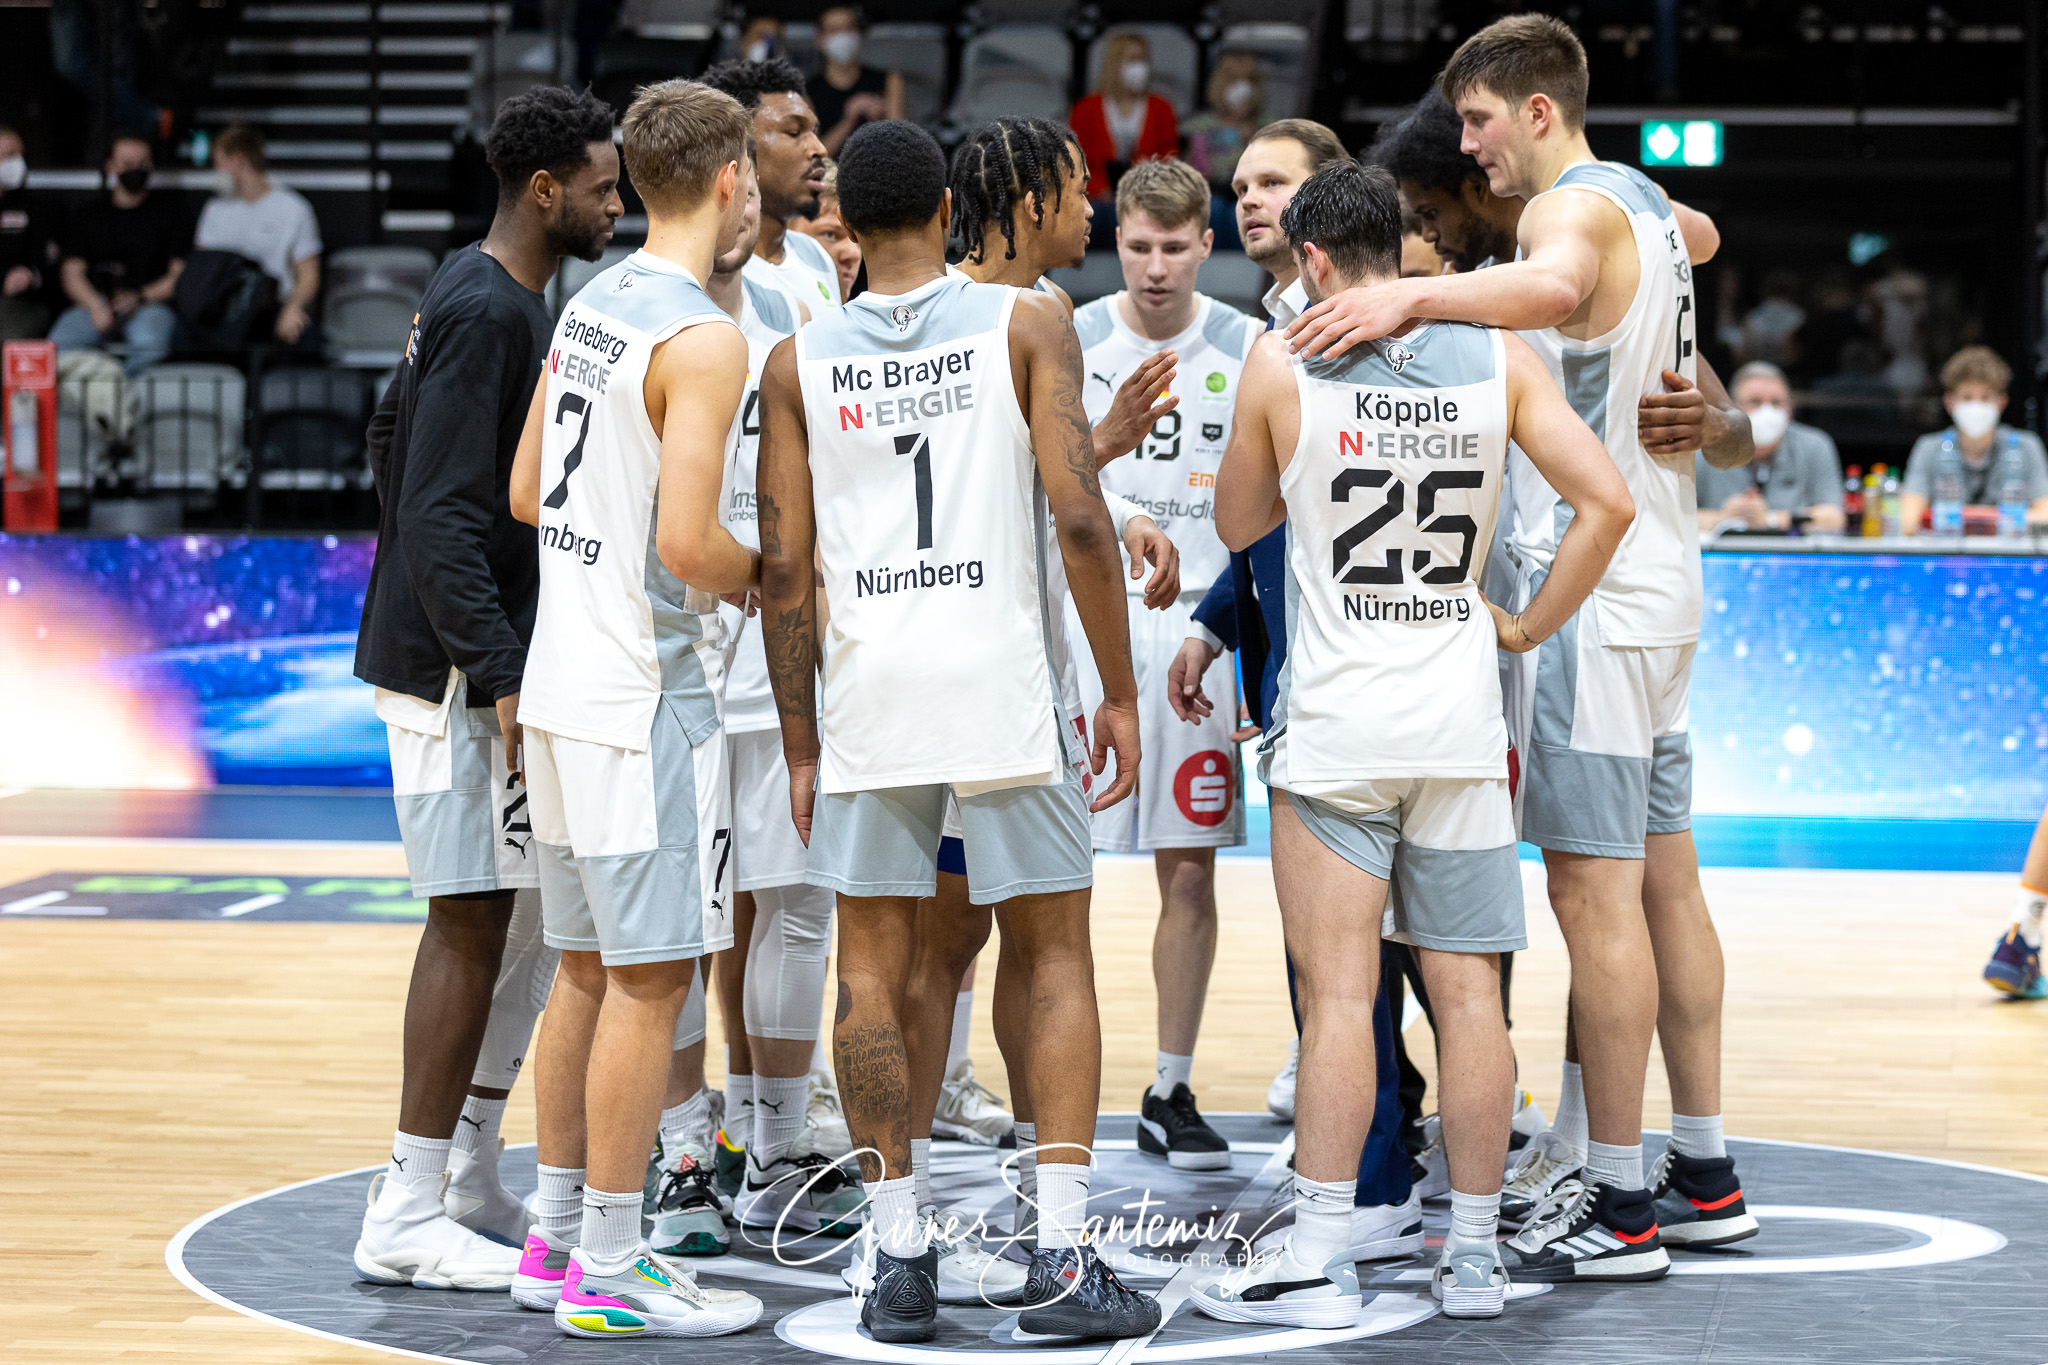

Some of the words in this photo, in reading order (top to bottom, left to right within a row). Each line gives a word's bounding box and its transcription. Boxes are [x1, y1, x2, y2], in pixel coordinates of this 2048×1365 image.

[832, 364, 873, 393] Mc
[883, 349, 974, 388] Brayer
[1356, 392, 1459, 427] Köpple
[543, 391, 593, 510] 7
[893, 432, 933, 550] 1
[1331, 468, 1485, 584] 25
[856, 560, 984, 598] Nürnberg
[1343, 594, 1471, 622] Nürnberg
[712, 828, 731, 893] 7
